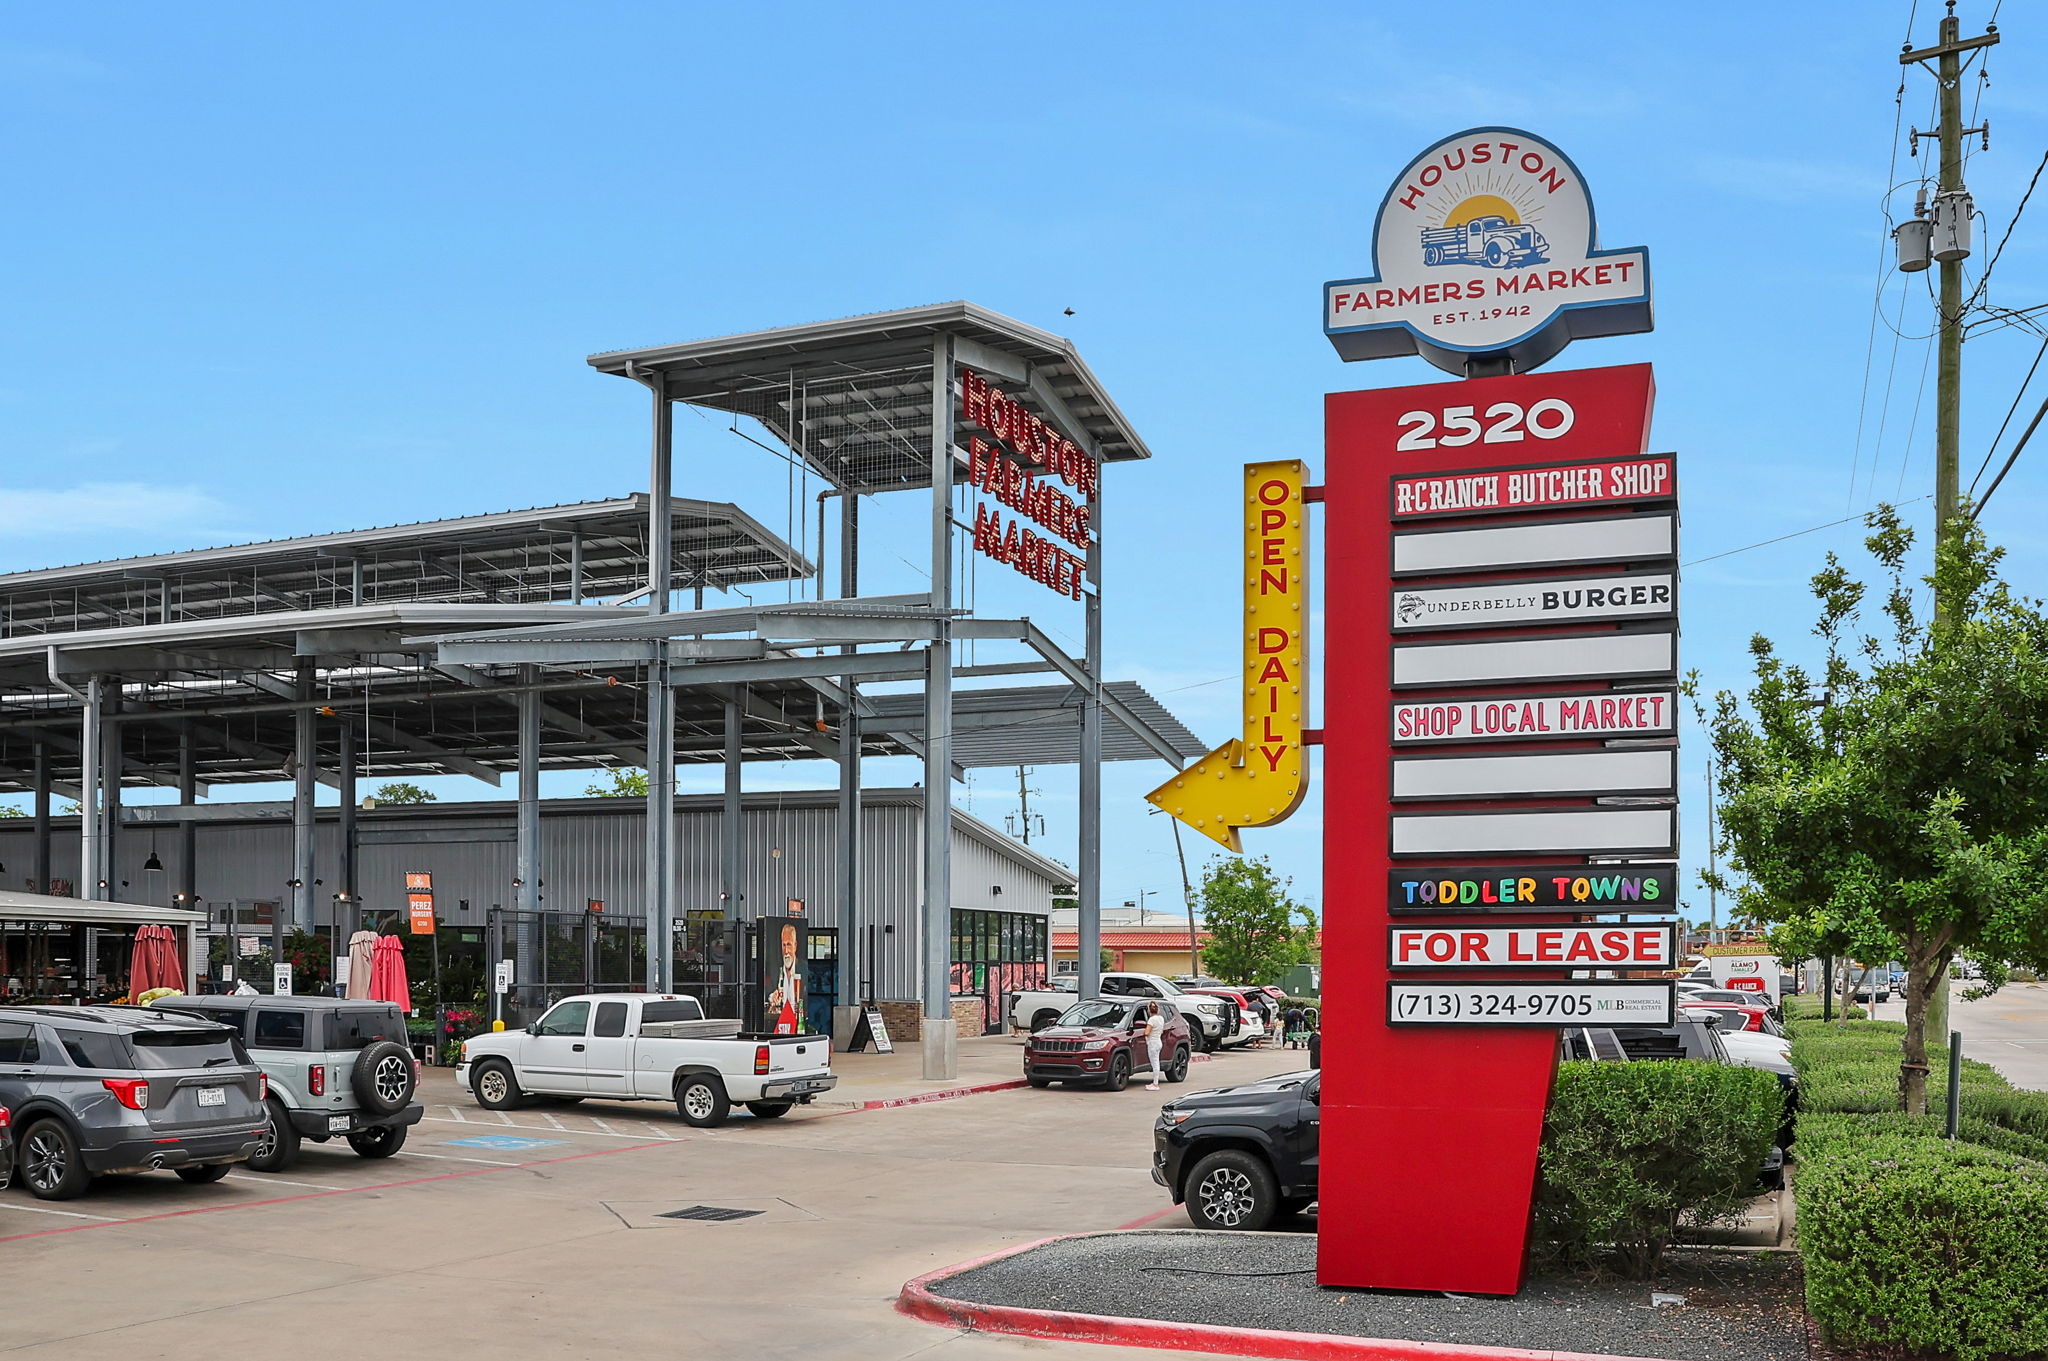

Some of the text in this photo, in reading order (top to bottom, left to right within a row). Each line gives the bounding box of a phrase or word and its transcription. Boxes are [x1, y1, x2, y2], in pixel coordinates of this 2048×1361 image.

[1398, 142, 1567, 211] HOUSTON
[1334, 262, 1635, 314] FARMERS MARKET
[963, 368, 1096, 503] HOUSTON
[1396, 398, 1575, 452] 2520
[969, 435, 1090, 549] FARMERS
[1429, 475, 1499, 510] RANCH
[1508, 467, 1603, 504] BUTCHER
[1610, 462, 1668, 497] SHOP
[974, 502, 1087, 602] MARKET
[1427, 584, 1670, 614] UNDERBELLY BURGER
[1258, 479, 1290, 772] OPEN DAILY
[1398, 696, 1665, 737] SHOP LOCAL MARKET
[411, 901, 432, 911] PEREZ
[1402, 875, 1661, 904] TODDLER TOWNS
[1398, 931, 1662, 963] FOR LEASE
[1712, 947, 1748, 955] CUSTOMER
[1397, 992, 1593, 1018] (713) 324-9705
[1597, 1000, 1624, 1010] MLB
